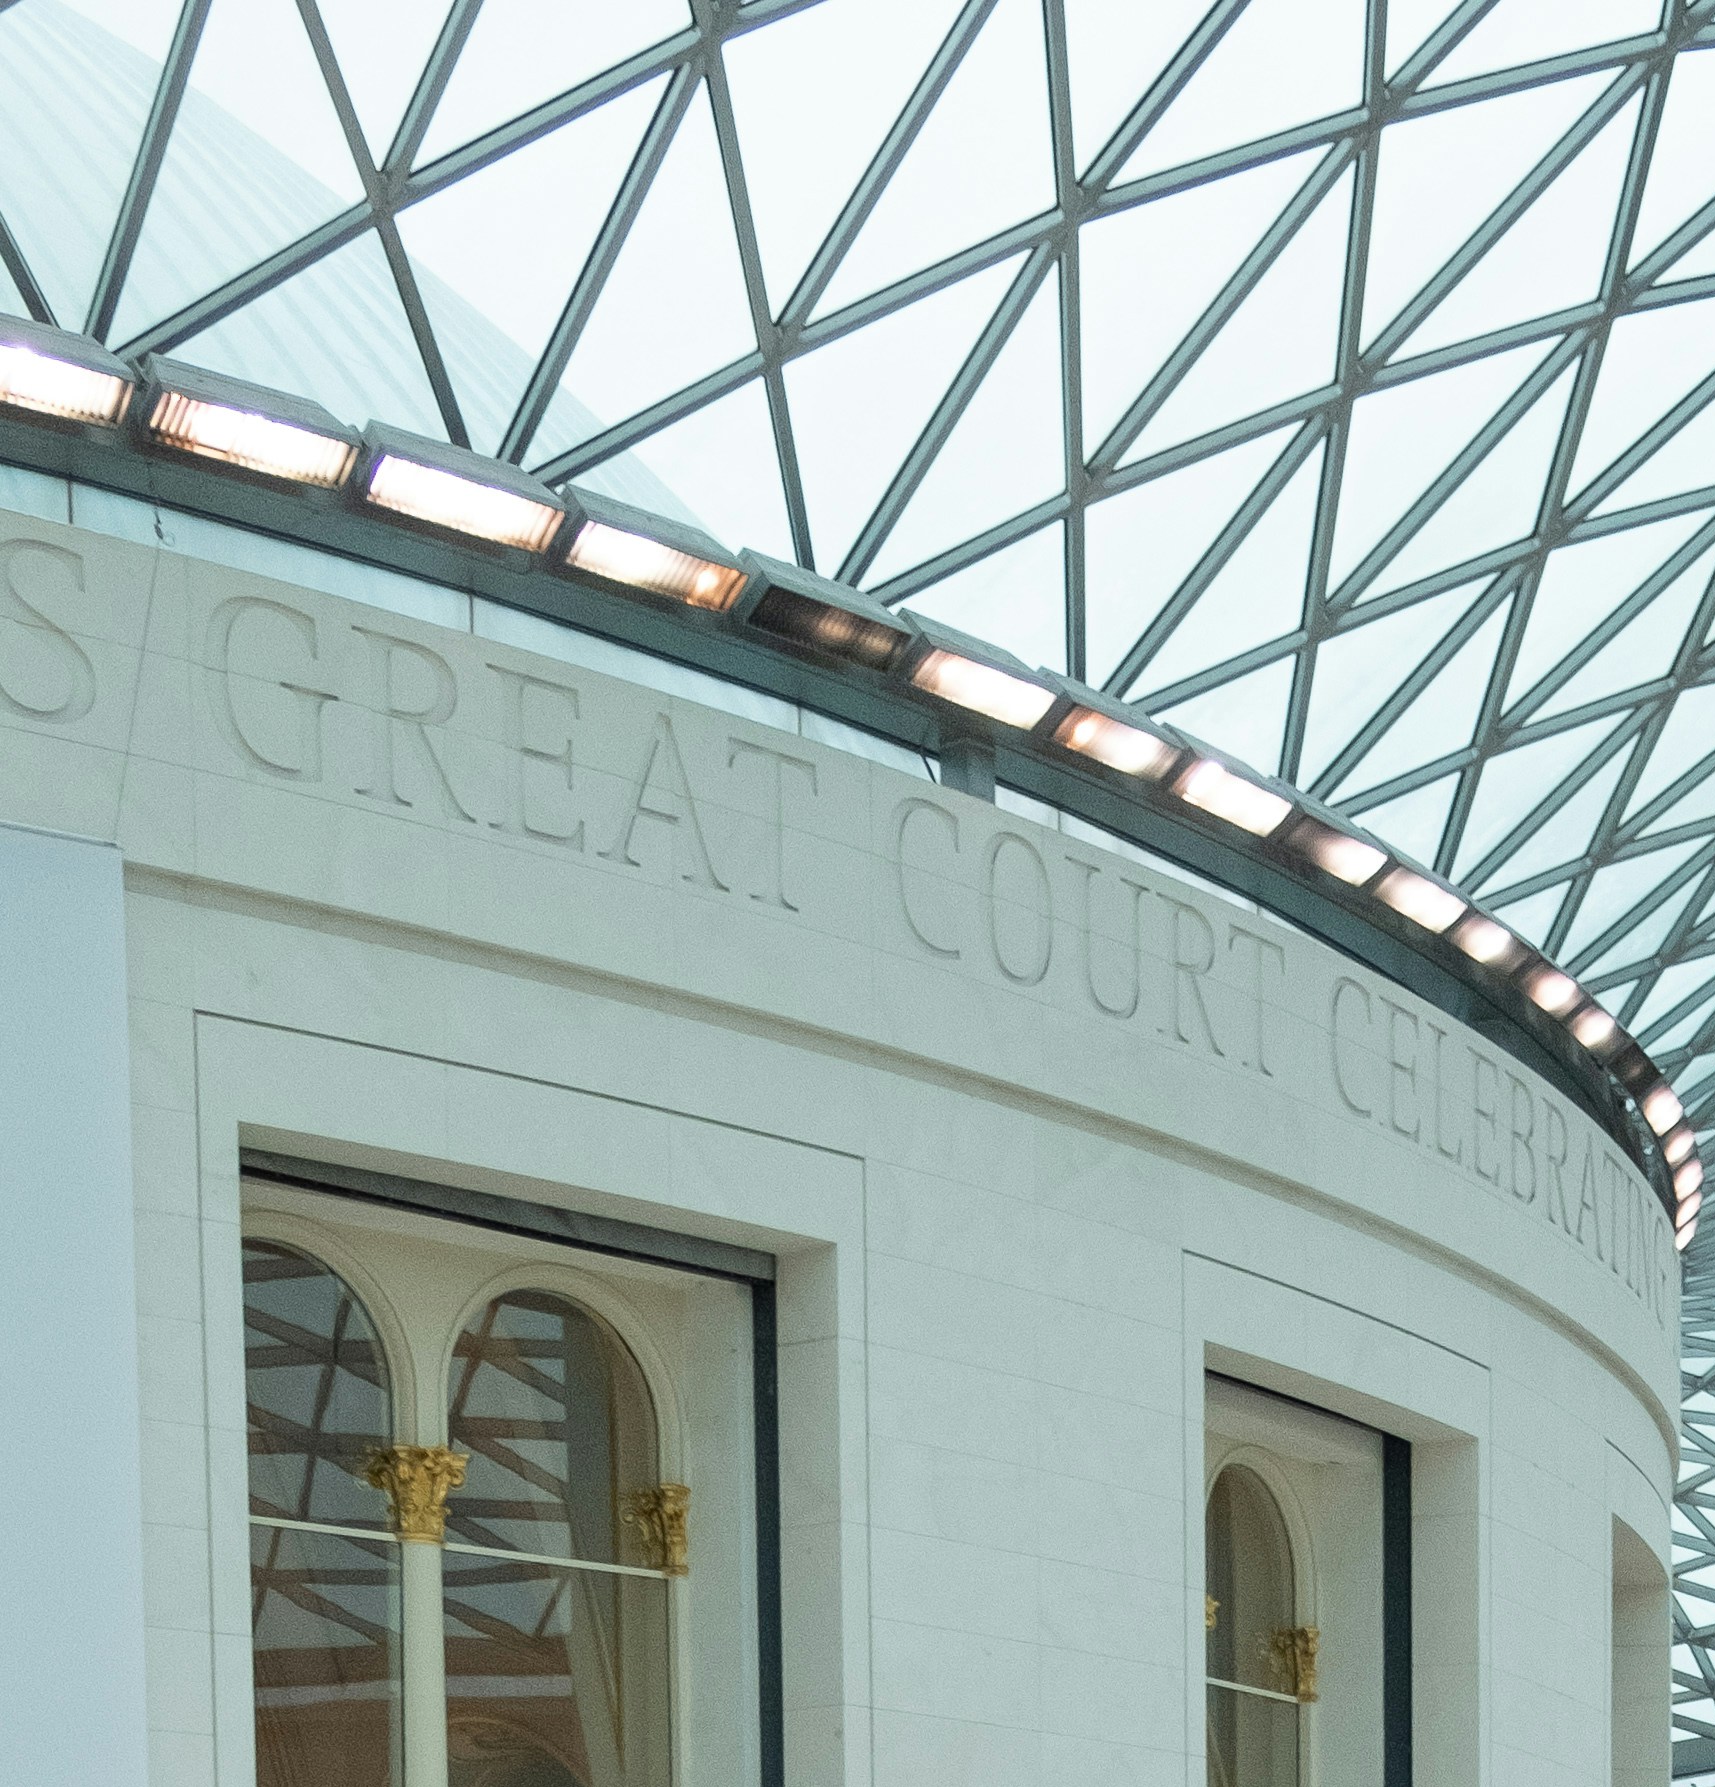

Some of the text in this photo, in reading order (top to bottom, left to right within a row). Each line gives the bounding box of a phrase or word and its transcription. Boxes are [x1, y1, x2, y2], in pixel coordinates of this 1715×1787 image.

[204, 595, 819, 912] GREAT
[894, 796, 1288, 1078] COURT
[1331, 976, 1667, 1332] CELEBRATING
